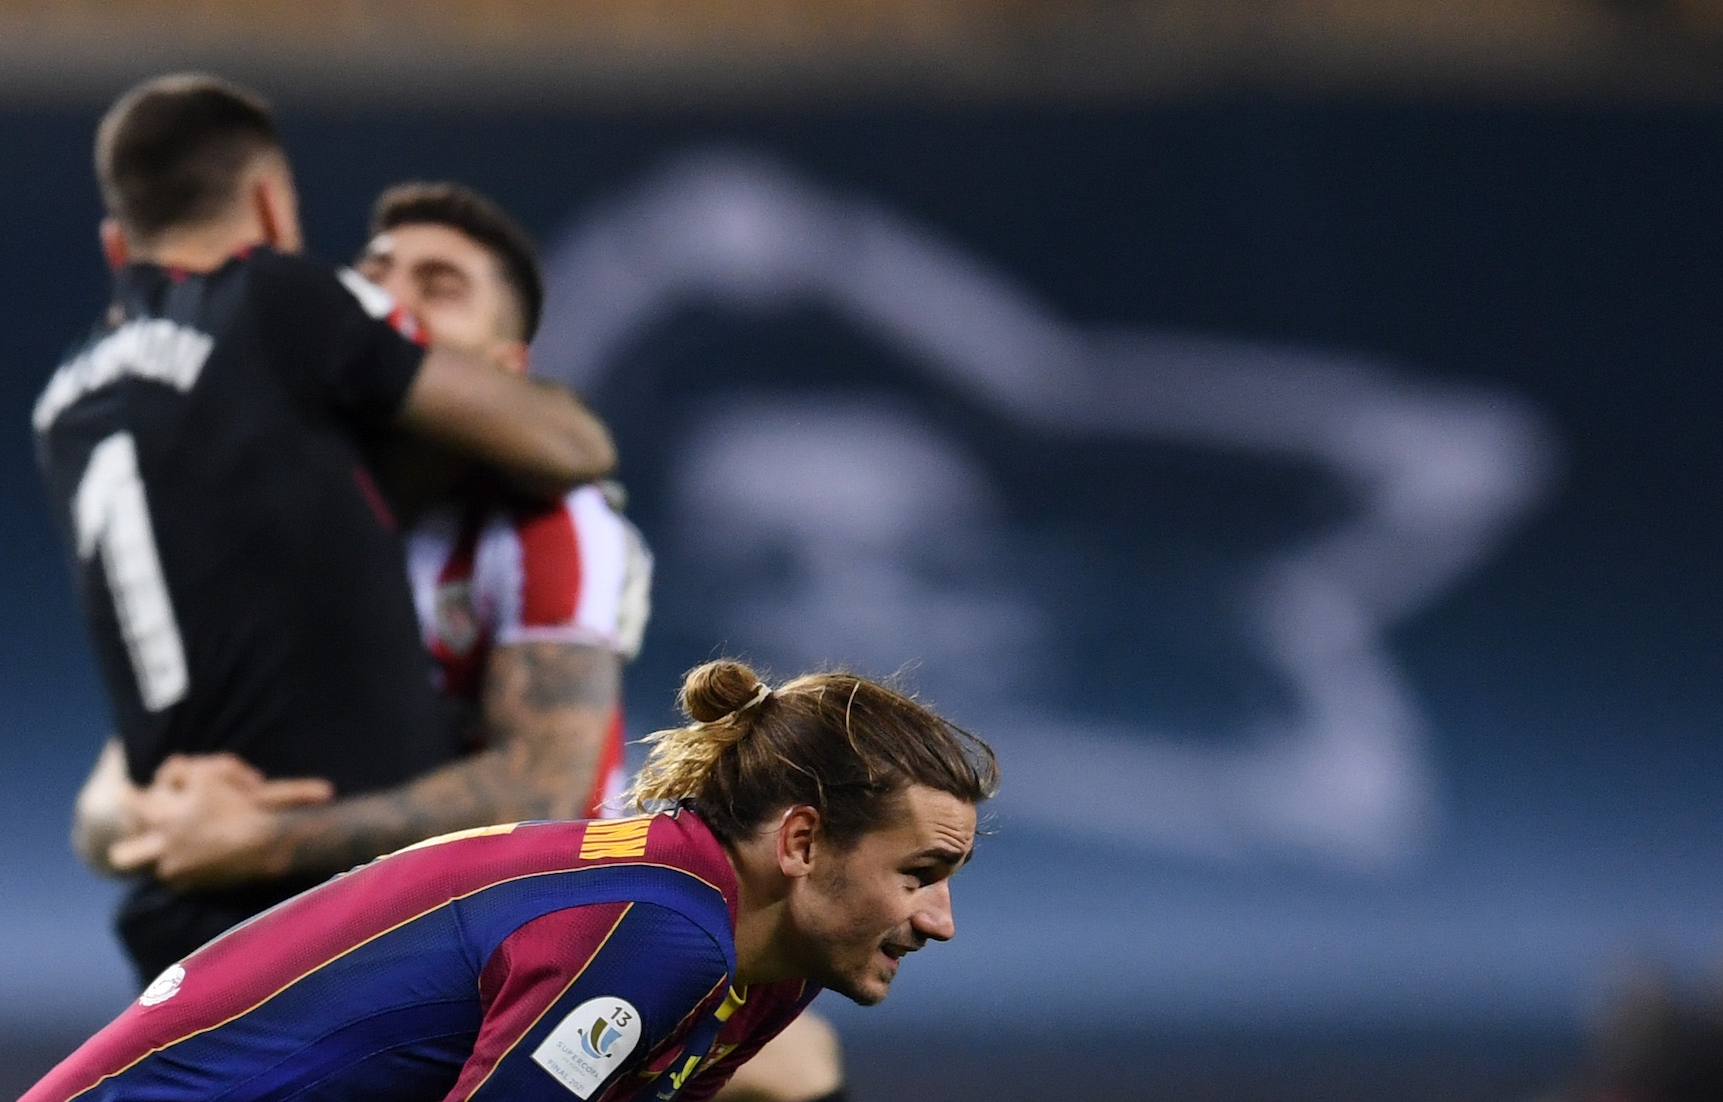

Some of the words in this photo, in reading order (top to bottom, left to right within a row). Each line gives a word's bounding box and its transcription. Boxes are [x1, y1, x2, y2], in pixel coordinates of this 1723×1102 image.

[74, 430, 189, 713] 1
[610, 1006, 633, 1028] 13
[546, 1059, 569, 1080] FINAL
[556, 1041, 600, 1079] SUPERCOPA
